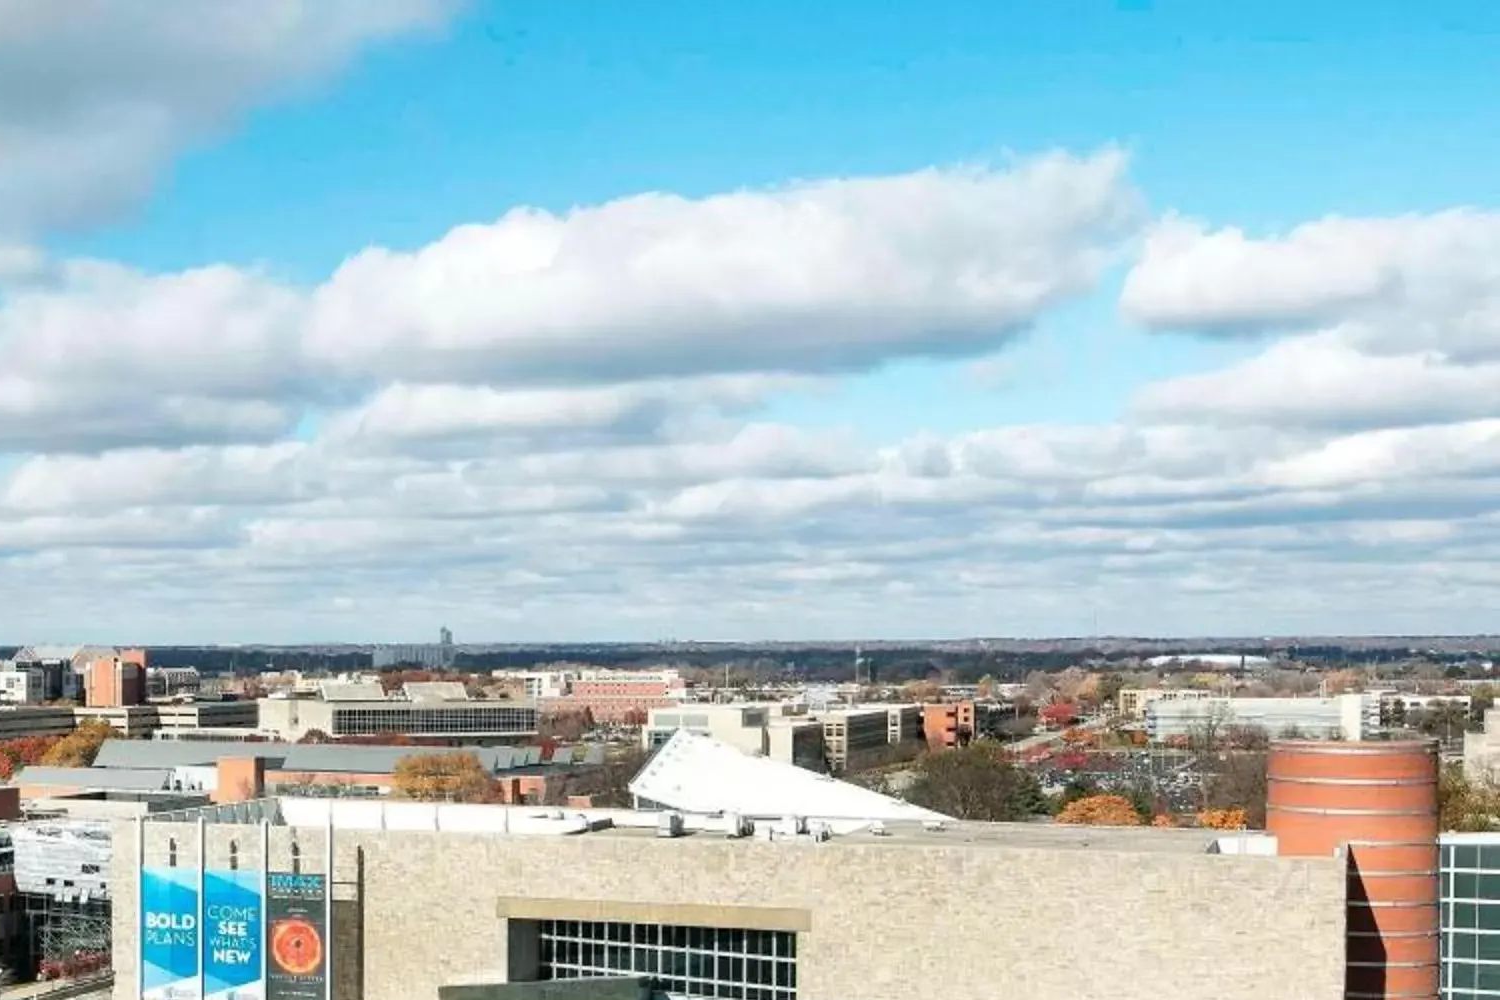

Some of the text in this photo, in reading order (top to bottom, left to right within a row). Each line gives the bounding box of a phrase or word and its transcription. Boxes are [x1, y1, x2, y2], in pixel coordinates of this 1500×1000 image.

[146, 912, 195, 929] BOLD
[207, 905, 258, 921] COME
[218, 920, 248, 937] SEE
[146, 930, 195, 947] PLANS
[213, 948, 251, 964] NEW
